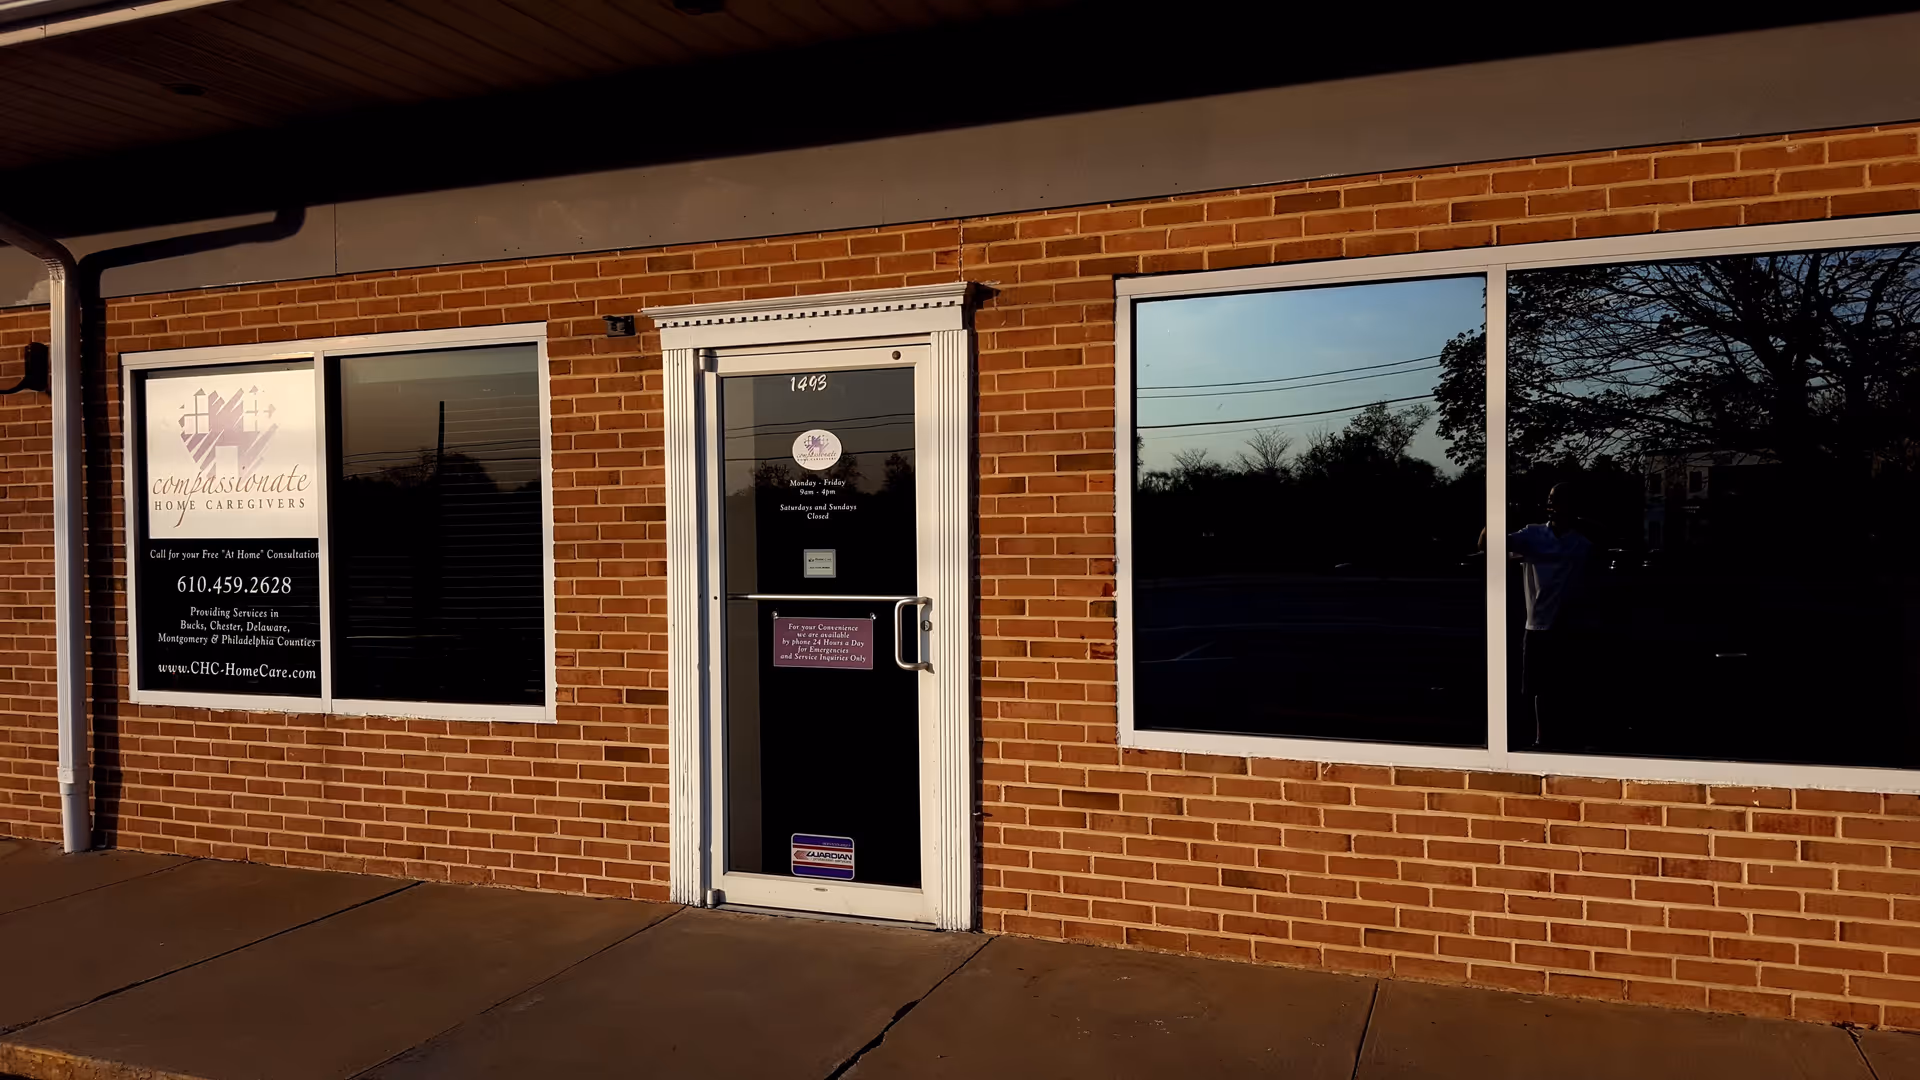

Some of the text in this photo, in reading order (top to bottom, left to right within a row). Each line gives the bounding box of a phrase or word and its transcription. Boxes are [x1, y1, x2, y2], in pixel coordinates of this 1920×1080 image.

[790, 374, 828, 392] 1493
[152, 464, 311, 528] compassionate
[155, 498, 305, 511] HOME CAREGIVERS
[150, 550, 166, 559] Call
[168, 550, 179, 560] for
[182, 552, 199, 560] your
[202, 550, 219, 559] Free
[222, 550, 234, 559] "At
[237, 550, 263, 559] Home"
[177, 576, 291, 594] 610.459.2628
[190, 607, 279, 619] Providing Services in
[180, 620, 290, 633] Bucks, Chester, Delaware,
[158, 633, 316, 647] Montgomery & Philadelphia Counties
[810, 646, 848, 654] Emergencies
[158, 661, 316, 679] www.CHC-HomeCare.com
